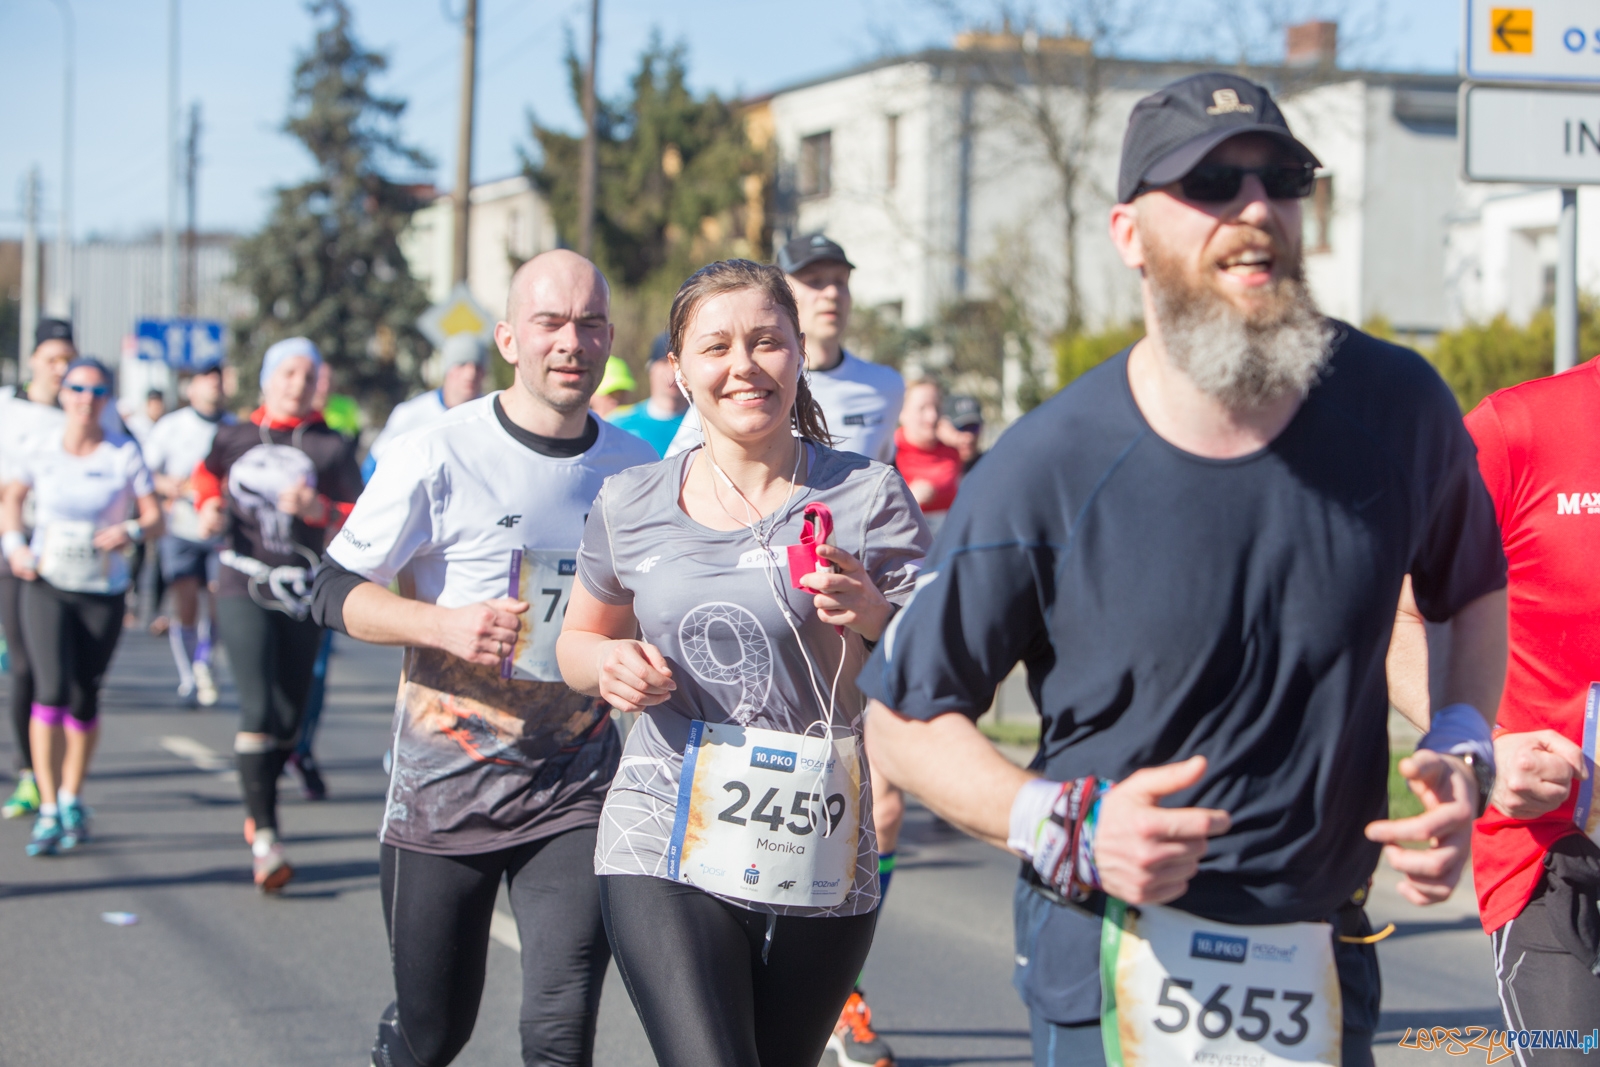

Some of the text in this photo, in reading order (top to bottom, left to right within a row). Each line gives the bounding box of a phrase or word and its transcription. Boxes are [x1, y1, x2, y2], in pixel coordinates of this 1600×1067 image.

[496, 514, 522, 528] 4F
[635, 555, 661, 574] 4F
[541, 588, 570, 623] 7
[678, 601, 773, 720] 9
[686, 727, 697, 754] 26.03.2017
[755, 752, 793, 767] 10. PKO
[717, 780, 846, 837] 2459
[756, 838, 806, 855] Monika
[777, 880, 797, 890] 4F
[1214, 940, 1245, 958] PKO
[1153, 976, 1314, 1046] 5653
